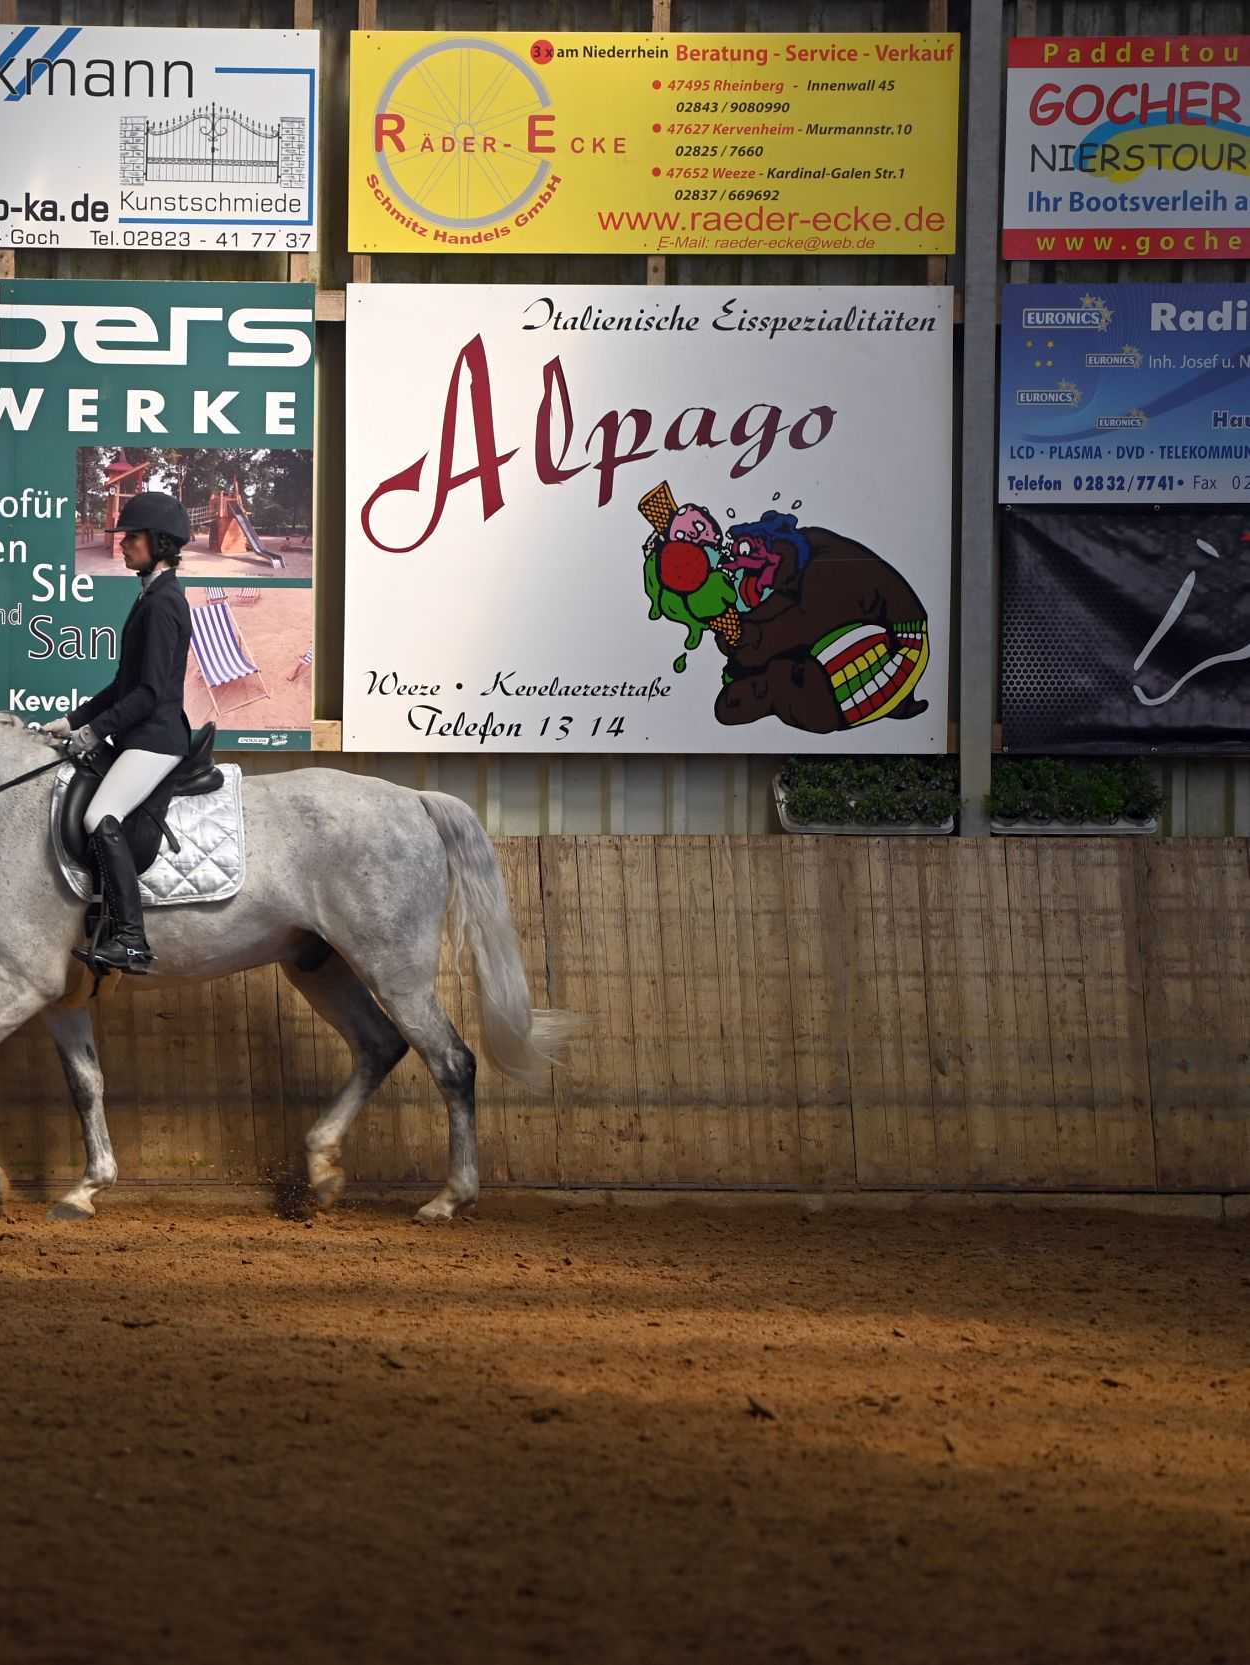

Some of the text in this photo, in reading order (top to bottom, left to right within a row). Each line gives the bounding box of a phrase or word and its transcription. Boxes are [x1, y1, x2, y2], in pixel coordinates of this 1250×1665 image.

[556, 48, 580, 59] am
[582, 44, 669, 59] Niederrhein
[675, 44, 769, 66] Beratung
[784, 43, 859, 63] Service
[875, 43, 955, 63] Verkauf
[1042, 41, 1239, 64] Paddeltou
[666, 79, 711, 92] 47495
[713, 78, 785, 94] Rheinberg
[806, 79, 875, 92] Innenwall
[877, 79, 896, 92] 45
[675, 101, 719, 114] 02843
[730, 101, 791, 114] 9080990
[1029, 81, 1243, 127] GOCHER
[666, 123, 711, 136] 47627
[712, 122, 795, 136] Kervenheim
[674, 145, 718, 158] 02825
[728, 145, 764, 158] 7660
[1030, 142, 1247, 173] NIERSTOUR
[665, 167, 709, 180] 47652
[711, 167, 757, 180] Weeze
[766, 166, 872, 181] Kardinal-Galen
[120, 190, 303, 214] Kunstschmiede
[674, 188, 718, 201] 02837
[728, 188, 780, 201] 669692
[1027, 191, 1063, 213] Ihr
[1069, 189, 1228, 213] Bootsverleih
[365, 173, 563, 245] Schmitz Handels GmbH
[597, 205, 947, 233] www.raeder-ecke.de
[9, 228, 60, 246] Goch
[215, 232, 239, 248] 41
[251, 232, 276, 248] 77
[285, 233, 312, 249] 37
[657, 235, 876, 252] E-Mail: raeder-ecke@web.de
[1035, 230, 1243, 257] www.goche
[521, 297, 938, 340] Italienische Eisspezialitäten
[1025, 311, 1101, 326] EURONICS
[1150, 300, 1248, 332] Radi
[1087, 355, 1136, 366] EURONICS
[1149, 354, 1177, 369] Inh.
[1180, 353, 1220, 369] Josef
[1221, 358, 1236, 369] u.
[1019, 392, 1074, 403] EURONICS
[1098, 418, 1143, 428] EURONICS
[360, 332, 839, 554] Alpago
[1009, 446, 1035, 460] LCD
[1048, 446, 1103, 460] PLASMA
[1115, 446, 1145, 460] DVD
[1007, 475, 1062, 492] Telefon
[1192, 474, 1217, 490] Fax
[31, 563, 95, 603] Sie
[365, 670, 672, 702] Weeze Kevelaererstraße
[407, 704, 626, 745] Telefon 13 14
